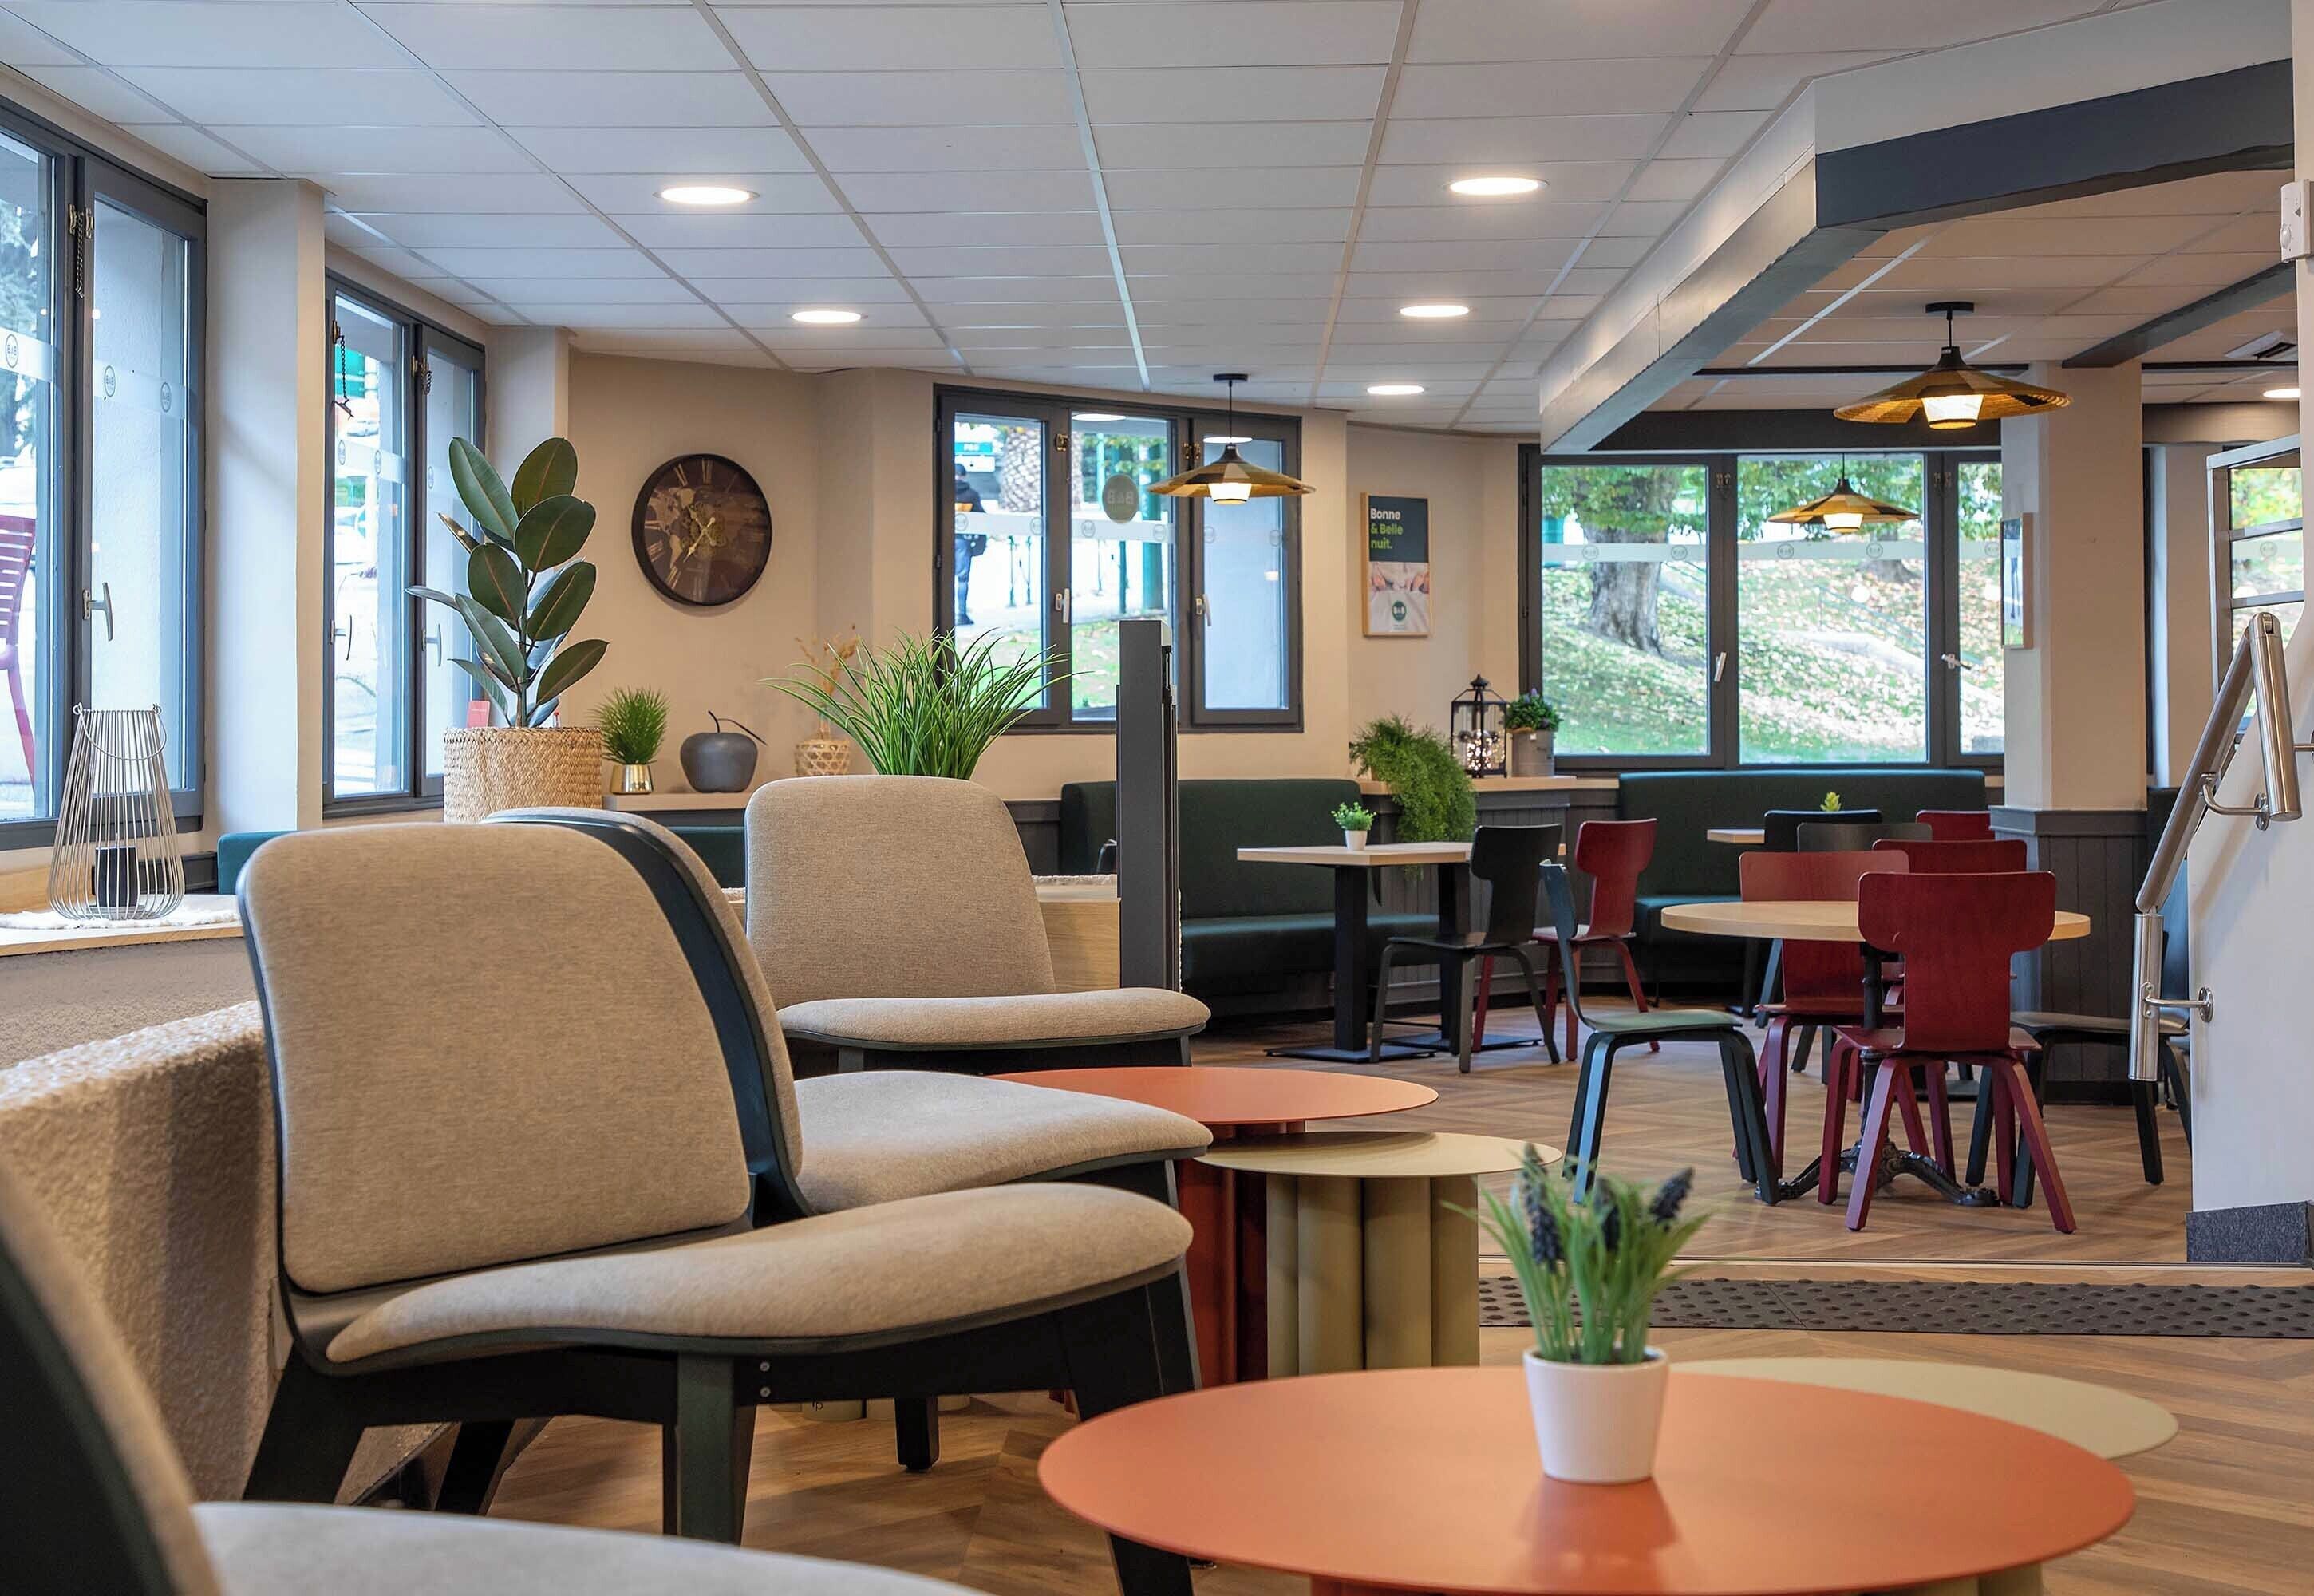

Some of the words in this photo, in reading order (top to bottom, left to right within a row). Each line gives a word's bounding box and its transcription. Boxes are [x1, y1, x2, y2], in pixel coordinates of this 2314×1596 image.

[1371, 508, 1401, 519] Bonne
[1380, 523, 1404, 535] Belle
[1371, 537, 1392, 549] nuit.
